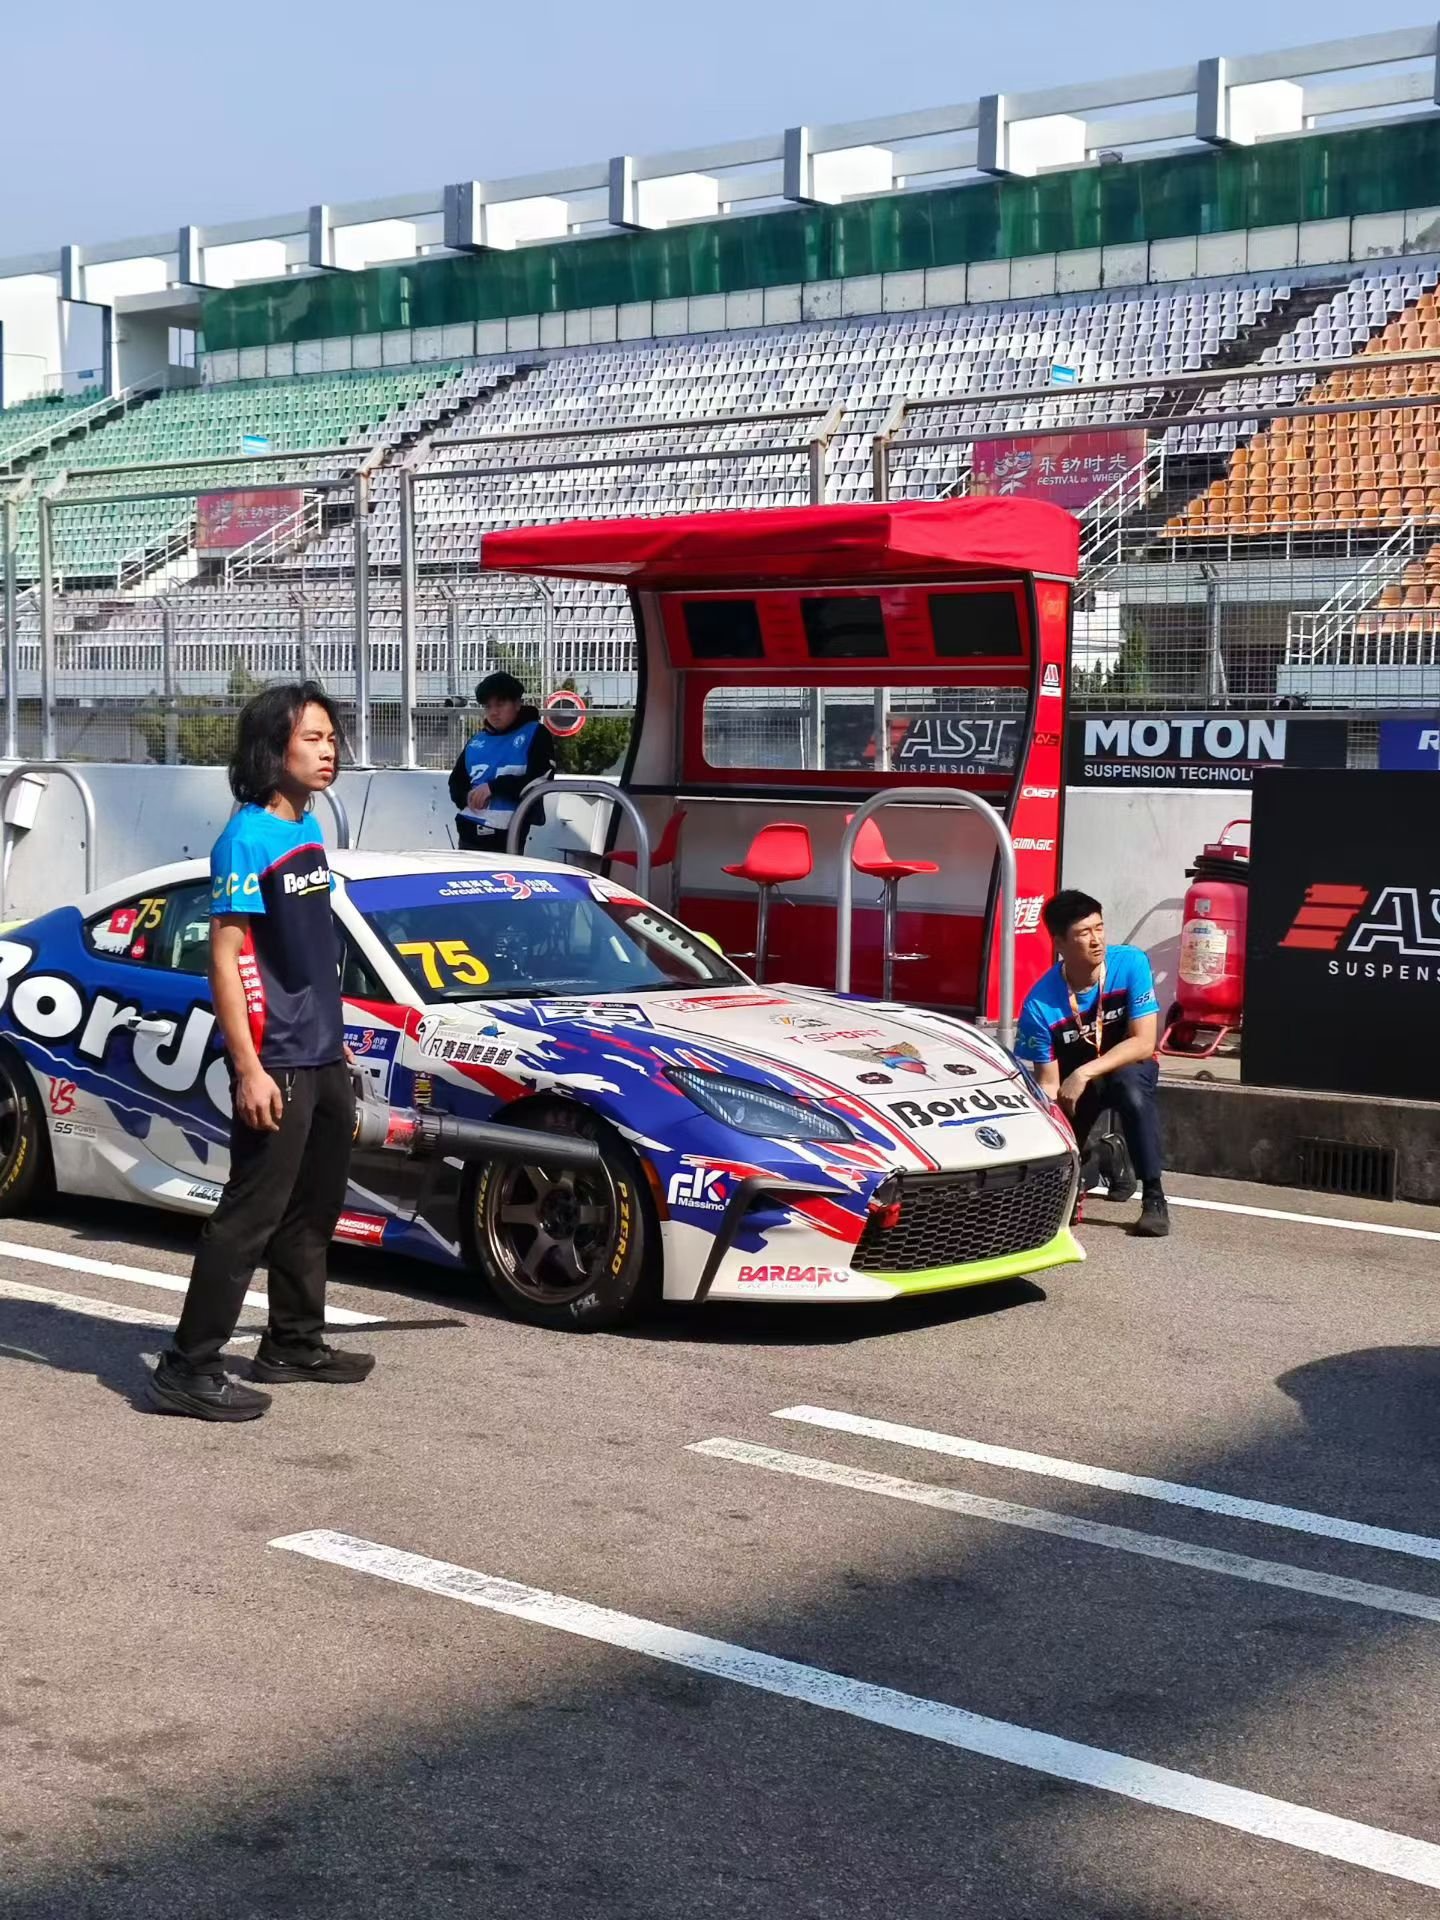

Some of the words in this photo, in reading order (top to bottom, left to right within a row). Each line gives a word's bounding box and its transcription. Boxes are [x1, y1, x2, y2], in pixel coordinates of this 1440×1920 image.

[1037, 475, 1079, 486] FESTIVAL
[1084, 719, 1286, 760] MOTON
[1084, 765, 1175, 779] SUSPENSION
[1179, 766, 1253, 782] TECHNOL
[439, 887, 484, 896] Circuit
[134, 898, 167, 929] 75
[395, 940, 490, 989] 75
[805, 1029, 887, 1042] SPORT
[887, 1089, 1030, 1129] Border
[54, 1121, 74, 1134] SS
[74, 1124, 97, 1134] POWER
[617, 1181, 628, 1198] P
[611, 1203, 629, 1275] ZERO
[738, 1265, 850, 1287] BARBARO
